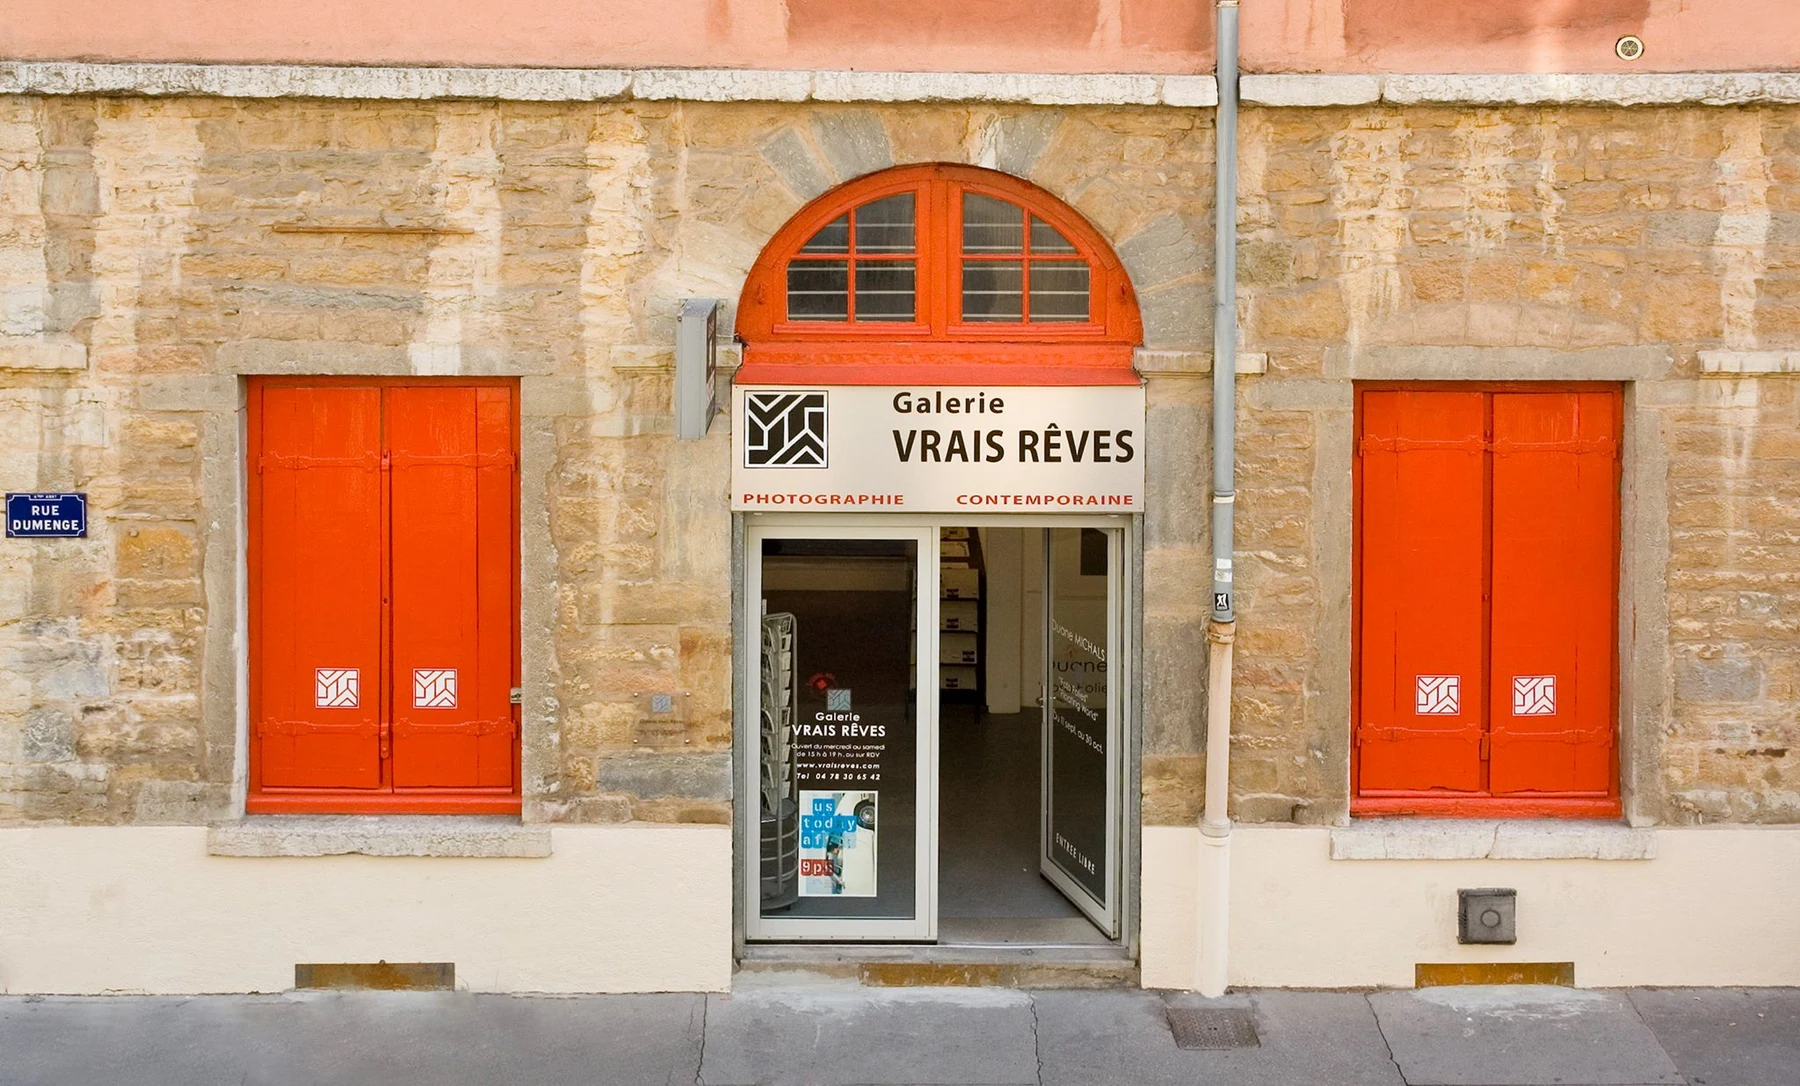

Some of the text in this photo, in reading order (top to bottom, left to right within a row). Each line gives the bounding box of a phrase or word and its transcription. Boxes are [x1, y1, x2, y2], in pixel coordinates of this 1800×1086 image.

[893, 391, 1005, 414] Galerie
[892, 422, 1135, 463] VRAIS RÊVES
[743, 493, 1134, 506] PHOTOGRAPHIE CONTEMPORAINE
[31, 505, 60, 516] RUE
[13, 519, 79, 531] DUMENGE
[815, 712, 860, 722] Galerie
[792, 722, 886, 737] VRAIS RÊVES
[814, 802, 833, 812] us
[1078, 852, 1095, 875] LIBRE
